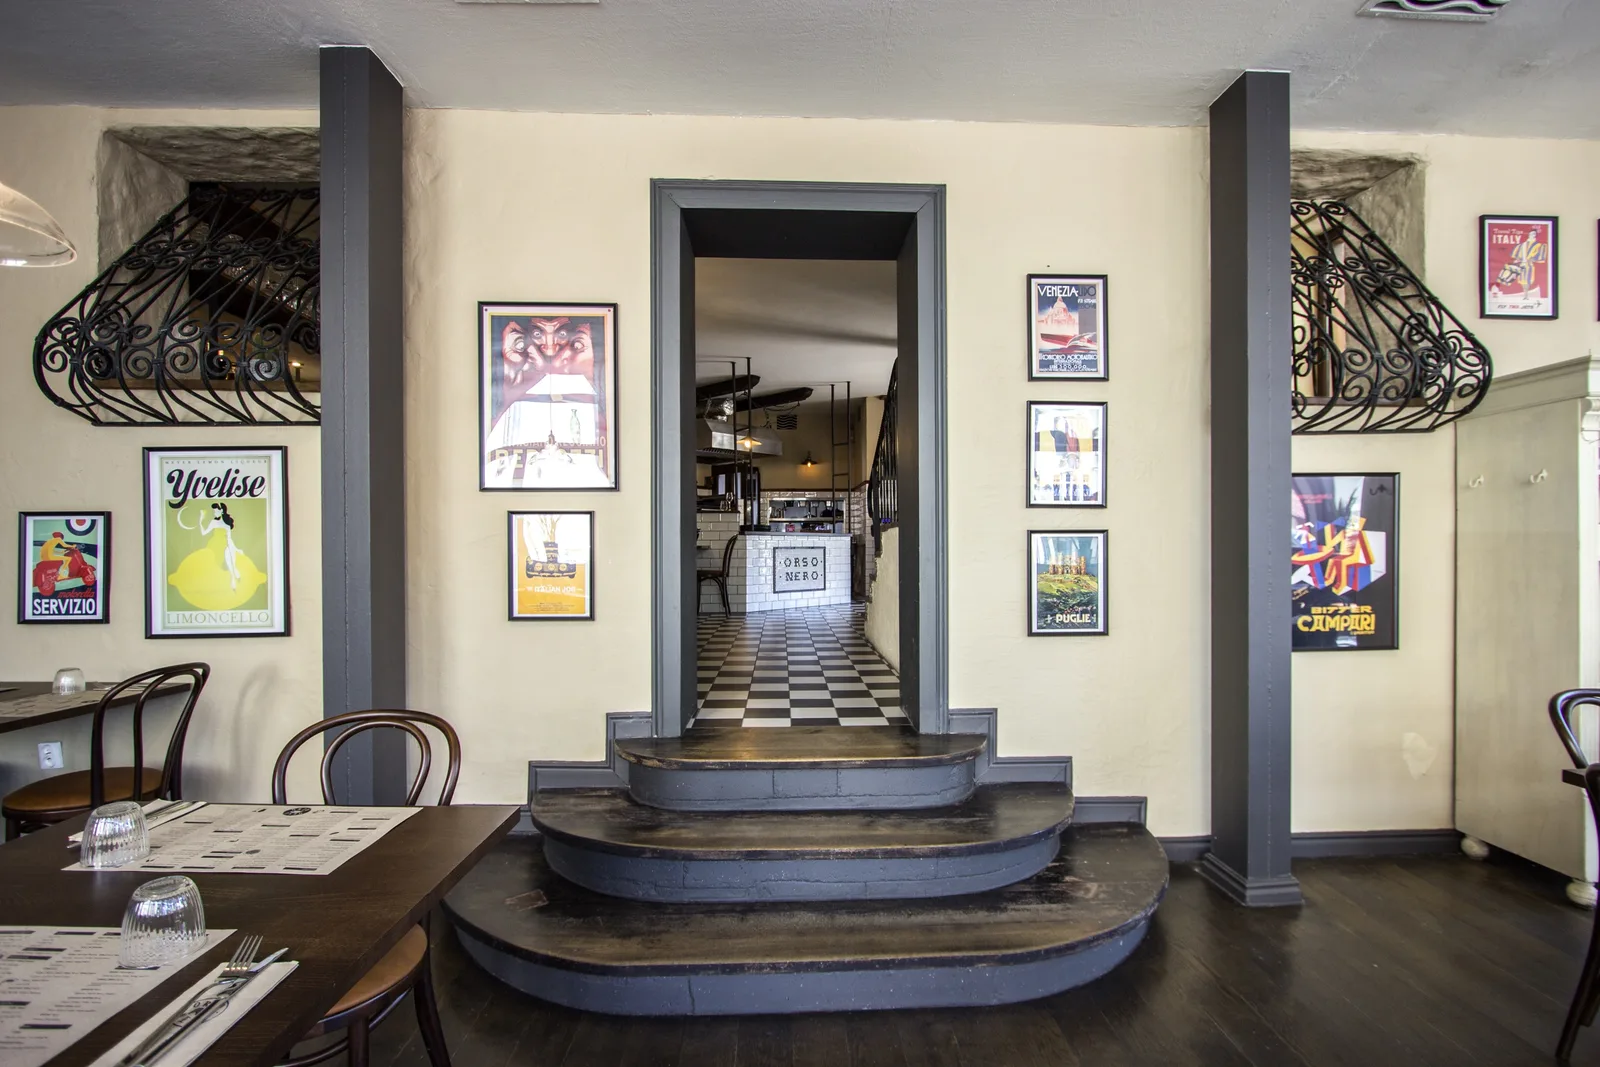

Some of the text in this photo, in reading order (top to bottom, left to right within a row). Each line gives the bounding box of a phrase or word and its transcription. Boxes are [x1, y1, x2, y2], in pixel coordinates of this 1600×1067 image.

[1492, 235, 1522, 244] ITALY
[166, 468, 266, 509] Yvelise
[784, 557, 818, 567] ORSO
[785, 571, 818, 581] NERO
[33, 598, 96, 614] SERVIZIO
[1311, 605, 1373, 614] BITTER
[167, 612, 270, 624] LIMONCELLO
[1056, 613, 1091, 623] PUGLIE
[1297, 614, 1376, 632] CAMPARI
